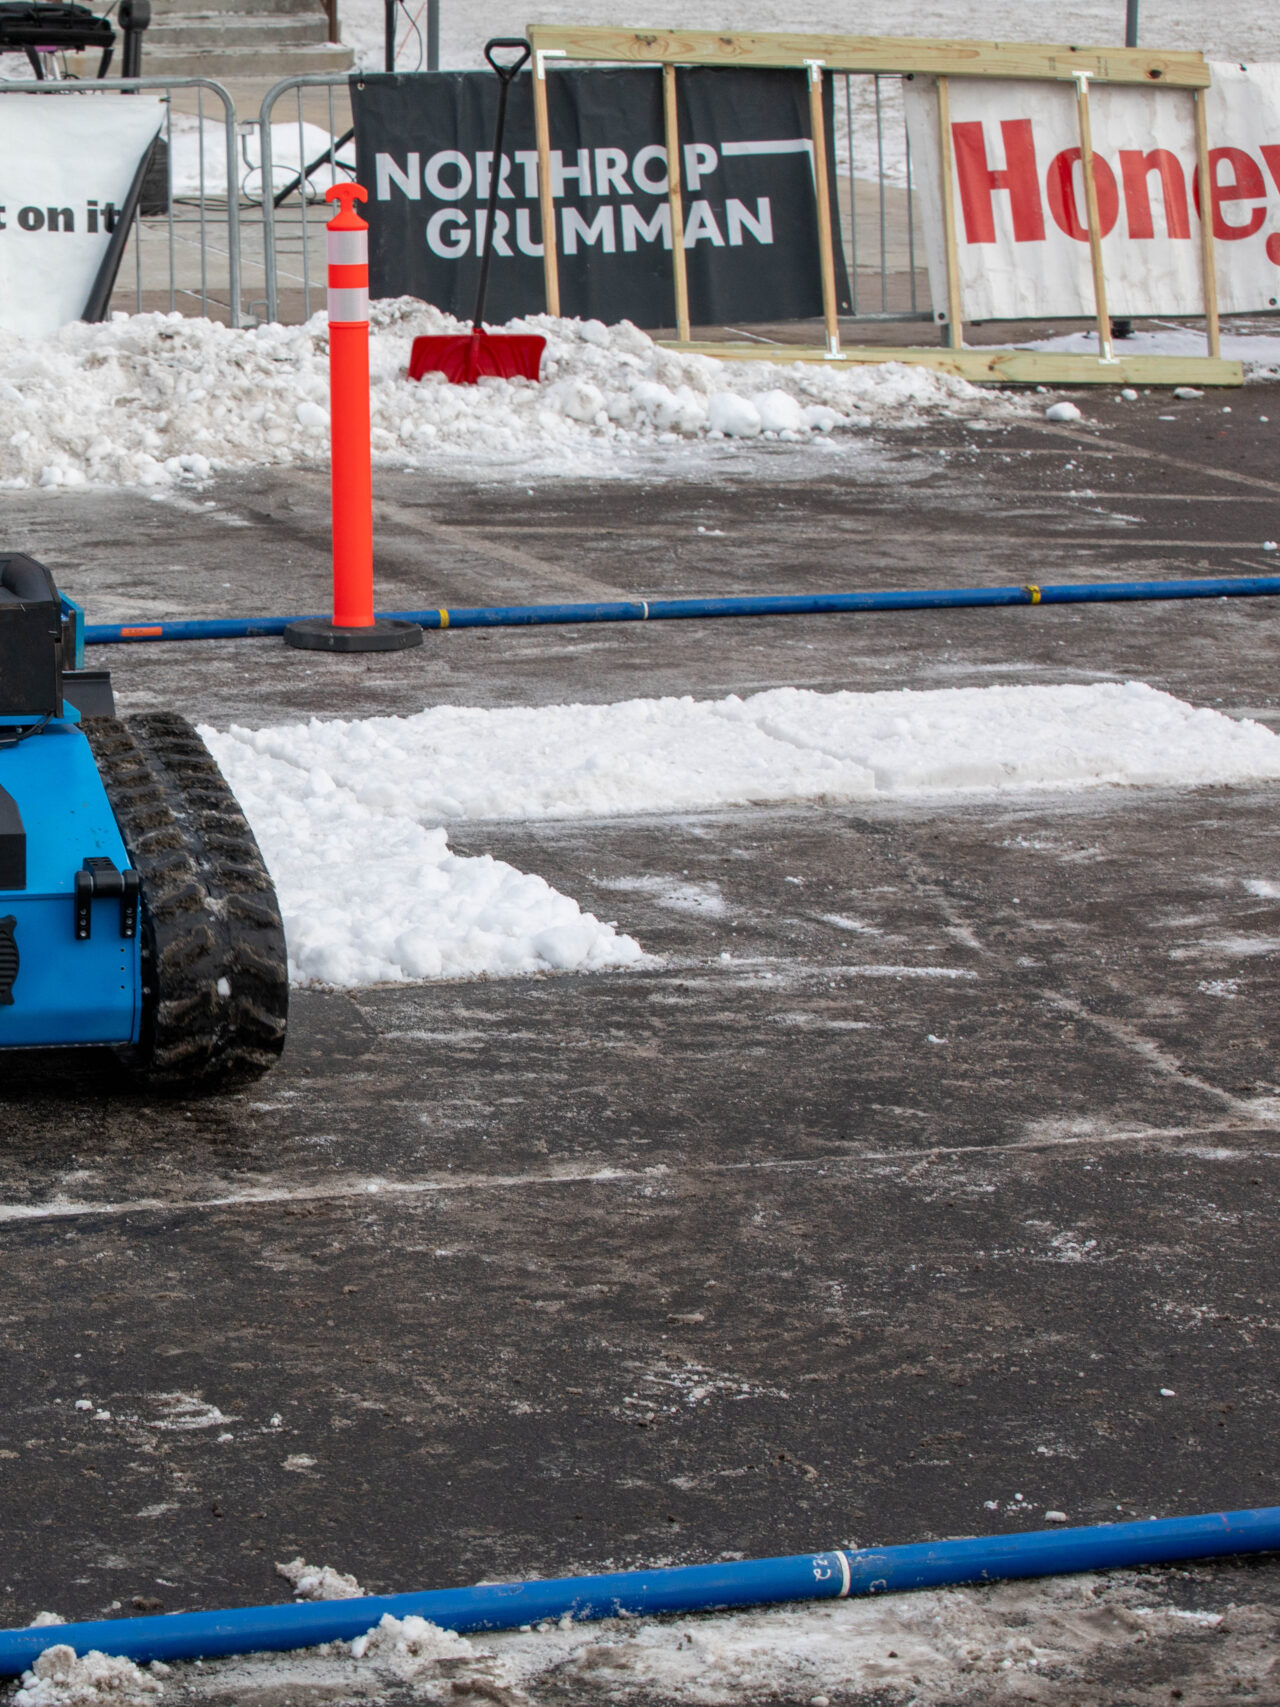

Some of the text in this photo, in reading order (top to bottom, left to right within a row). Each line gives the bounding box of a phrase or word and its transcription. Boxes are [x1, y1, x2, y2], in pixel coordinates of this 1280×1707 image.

[375, 143, 718, 201] NORTHROP
[951, 119, 1280, 267] Hone
[17, 205, 75, 233] on
[86, 199, 122, 235] it
[425, 196, 774, 259] GRUMMAN
